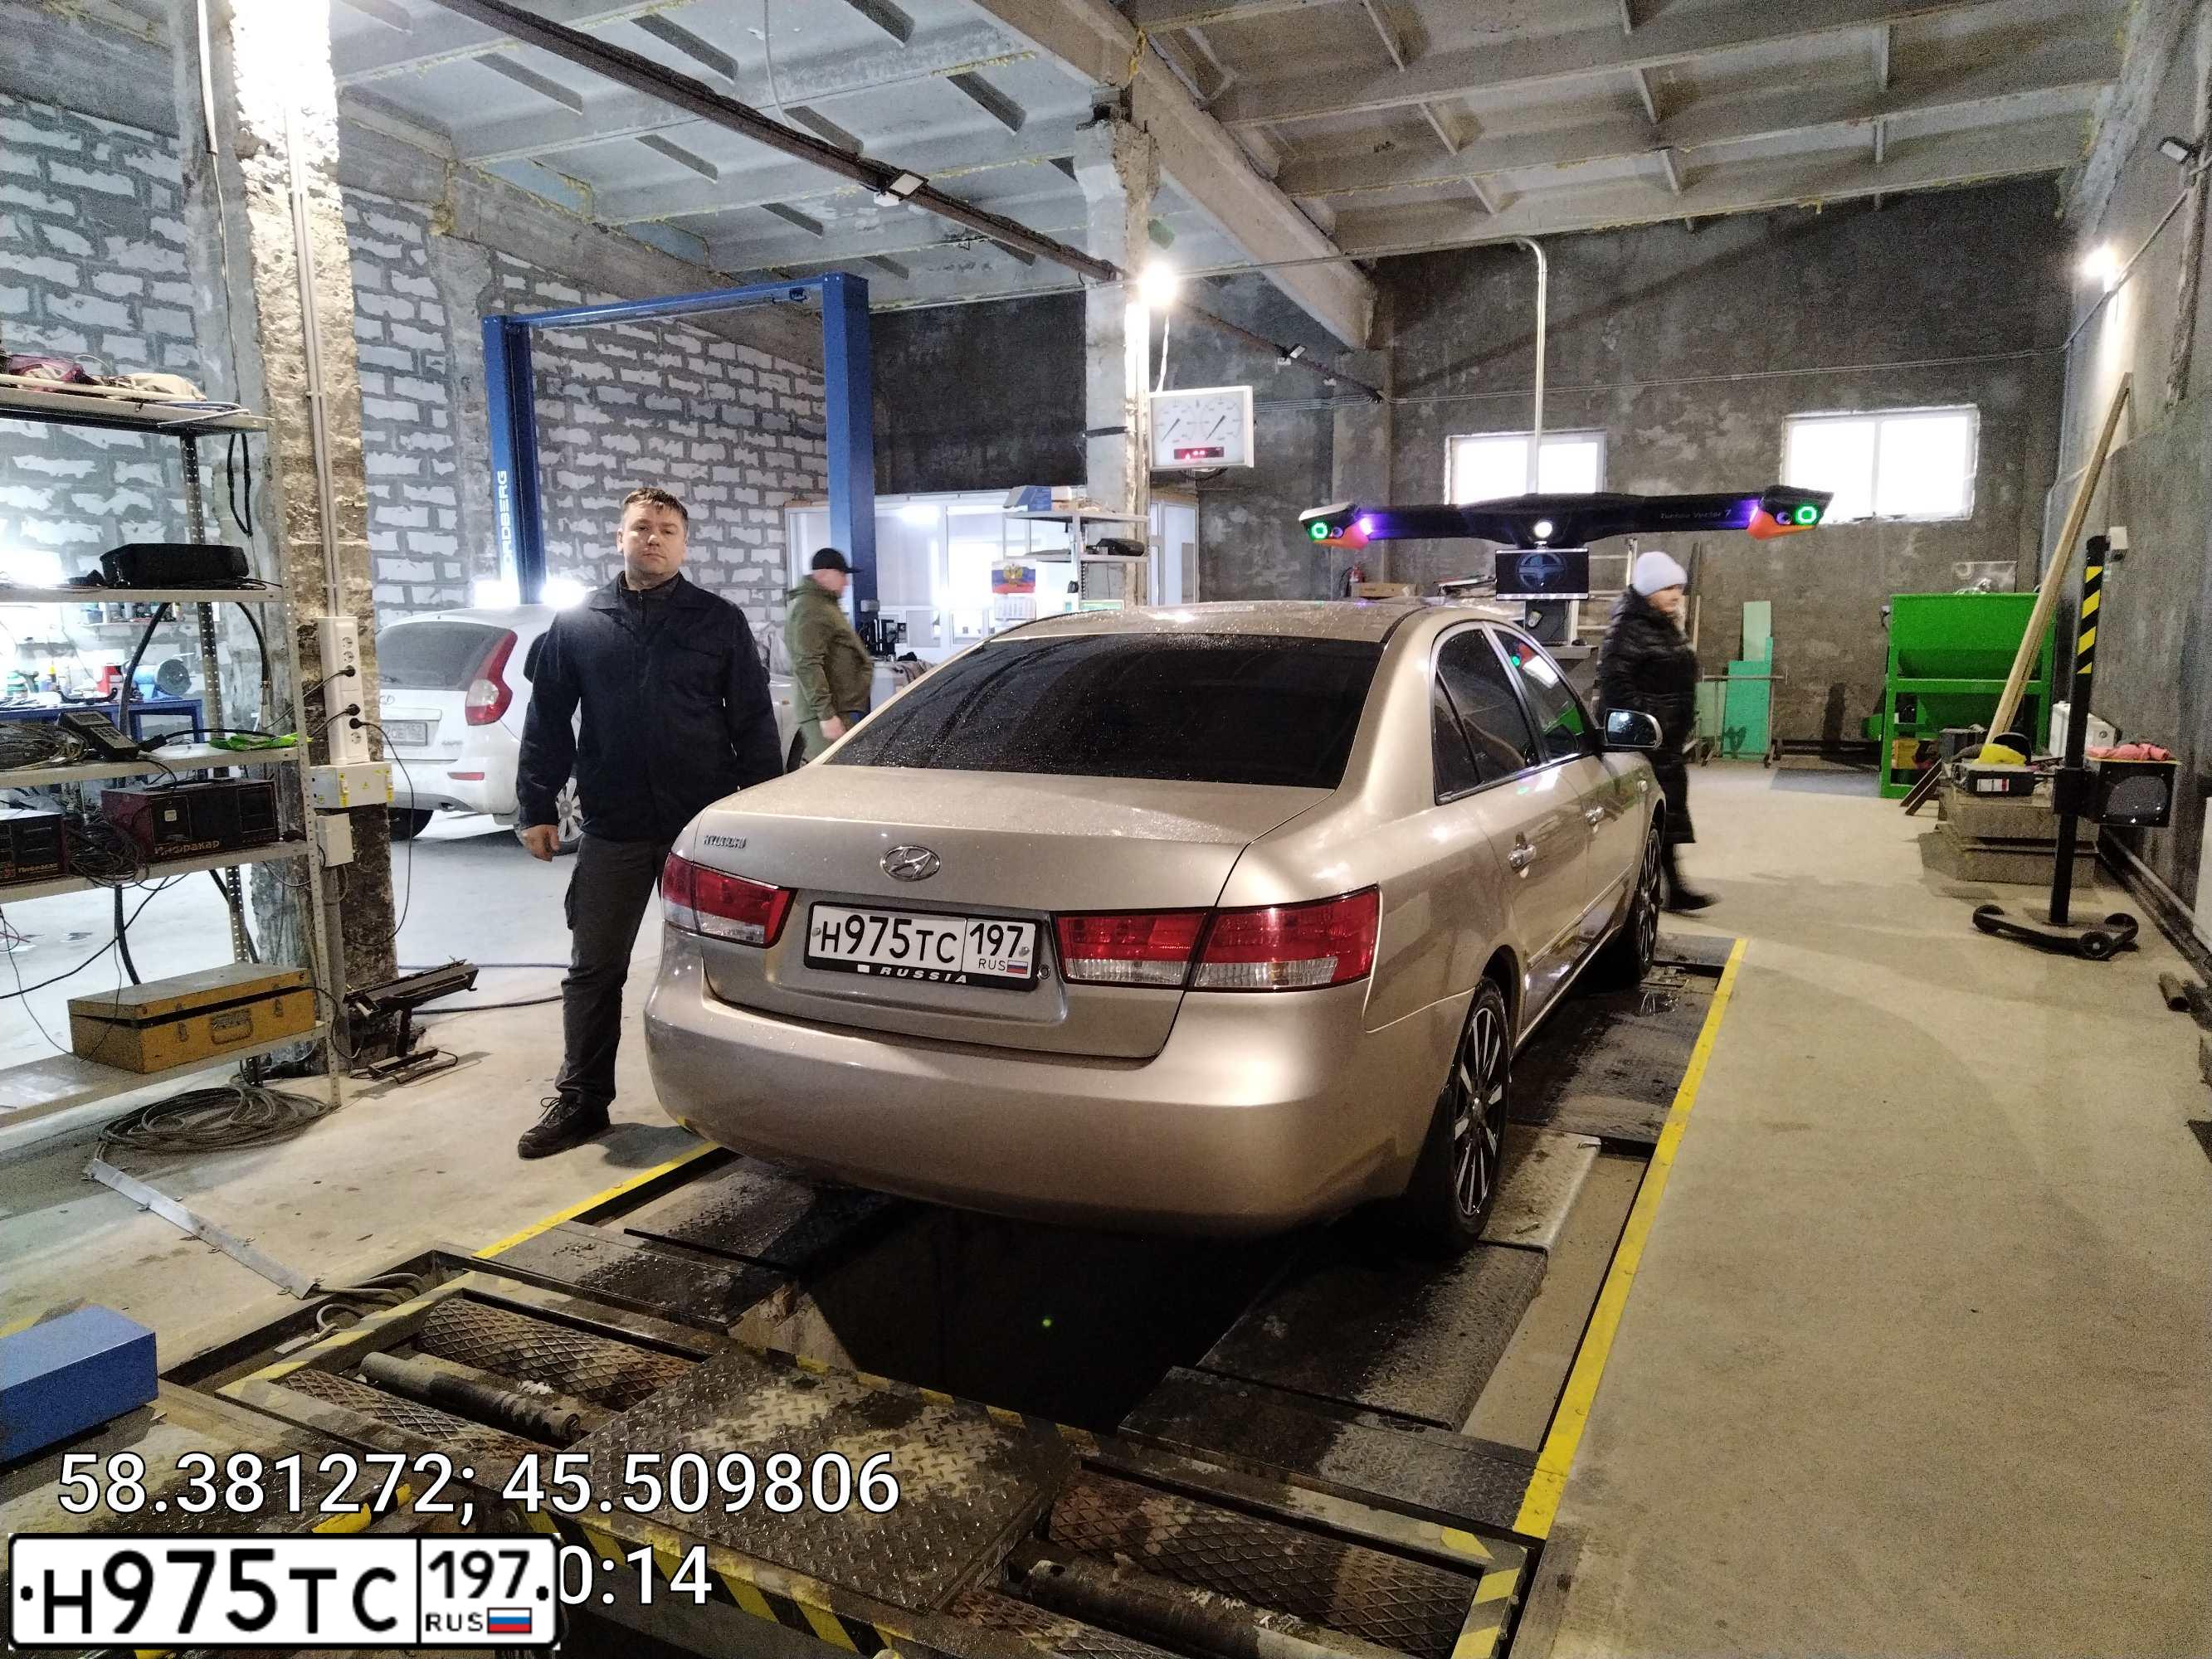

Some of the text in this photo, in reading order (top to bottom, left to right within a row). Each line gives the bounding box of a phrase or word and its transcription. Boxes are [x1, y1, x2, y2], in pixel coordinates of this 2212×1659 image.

[496, 470, 514, 565] ORDBERG
[969, 922, 1025, 958] 197
[879, 966, 967, 984] RUSSIA
[978, 958, 1006, 971] RUS
